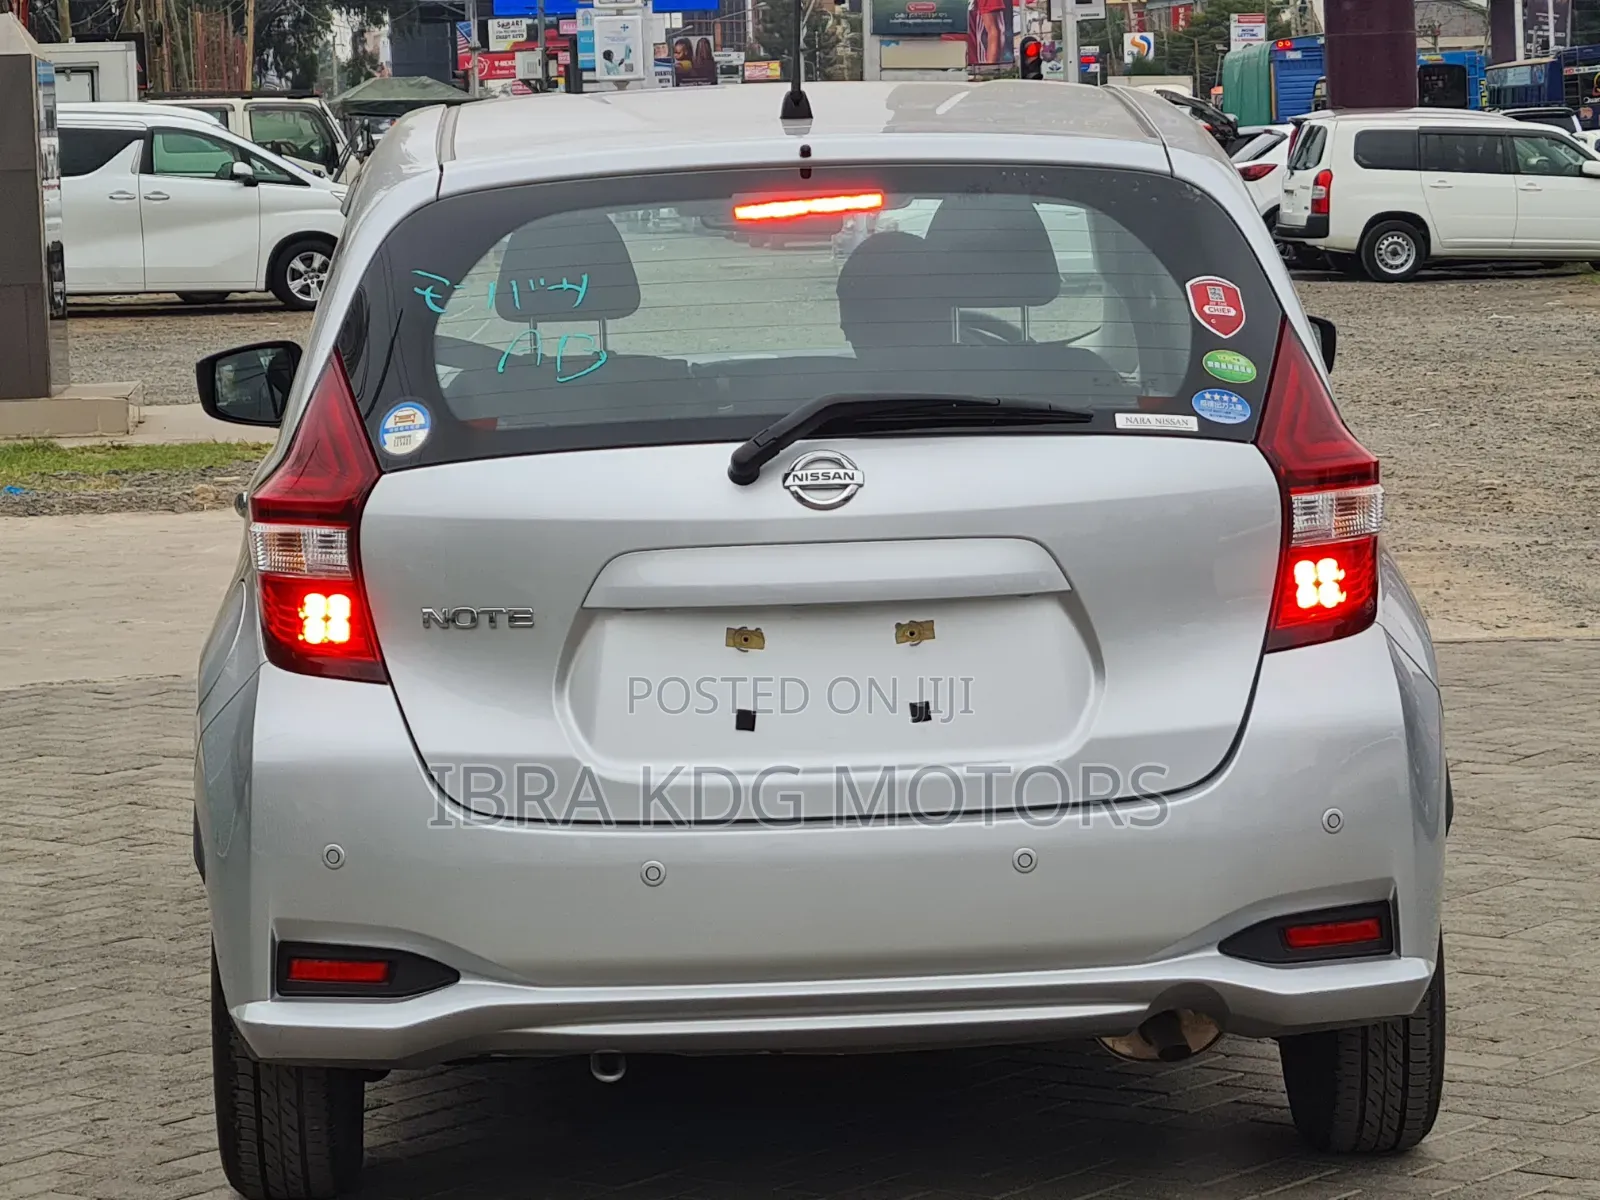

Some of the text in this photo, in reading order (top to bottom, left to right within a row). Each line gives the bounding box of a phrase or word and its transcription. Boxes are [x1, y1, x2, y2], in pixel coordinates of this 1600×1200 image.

[1125, 416, 1189, 427] NARA NISSAN
[791, 470, 856, 483] NISSAN
[421, 606, 535, 630] NOTE
